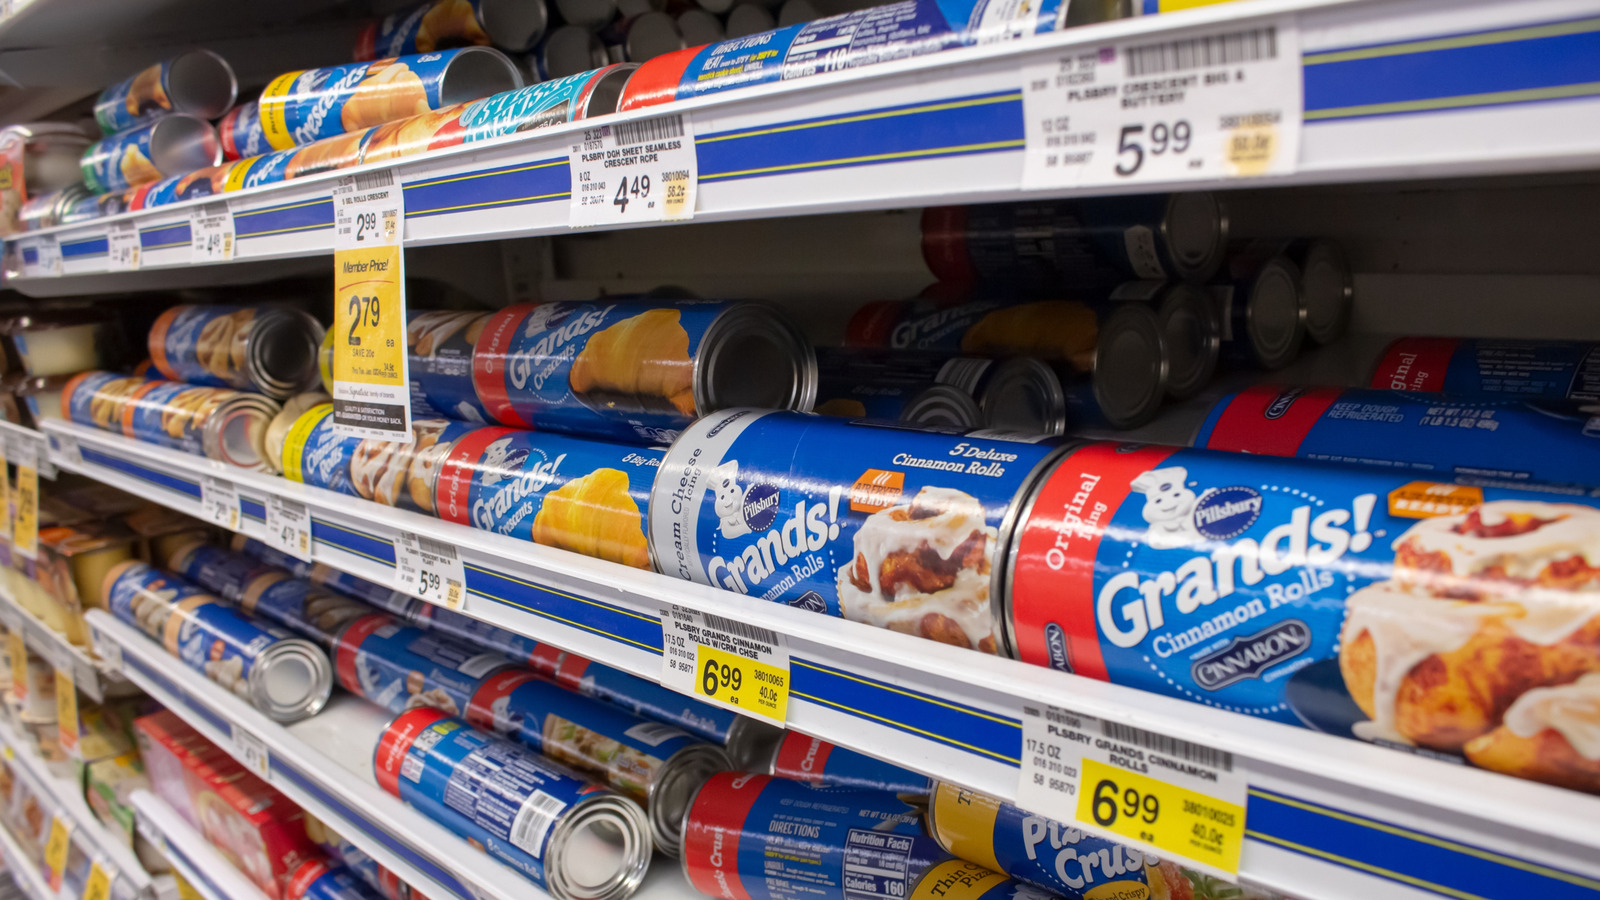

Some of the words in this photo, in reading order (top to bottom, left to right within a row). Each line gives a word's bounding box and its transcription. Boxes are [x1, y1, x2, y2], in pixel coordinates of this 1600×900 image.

[702, 54, 725, 71] HEAT
[784, 61, 816, 80] Calories
[824, 47, 847, 72] 110
[1123, 75, 1198, 95] CRESCENT
[1204, 71, 1230, 86] BIG
[581, 151, 605, 163] PLSBRY
[606, 149, 621, 159] DGH
[622, 146, 643, 157] SHEET
[644, 140, 682, 154] SEAMLESS
[604, 157, 638, 168] CRESCENT
[640, 153, 659, 164] RCPE
[579, 172, 584, 182] 8
[583, 171, 591, 182] OZ
[367, 191, 389, 201] CRESCENT
[343, 261, 369, 274] Member
[369, 259, 389, 272] Price!
[386, 339, 395, 347] ea
[485, 312, 515, 374] Original
[510, 304, 617, 390] Grands!
[534, 343, 576, 390] Crescents
[1327, 410, 1405, 423] REFRIGERATED
[1331, 402, 1362, 411] KEEP
[1361, 404, 1400, 413] DOUGH
[621, 453, 637, 462] 8
[629, 455, 648, 466] Big
[949, 442, 969, 456] 5
[962, 447, 1018, 463] Deluxe
[892, 453, 965, 474] Cinnamon
[964, 462, 1006, 478] Rolls
[449, 452, 470, 517] Original
[473, 453, 567, 532] Grands!
[671, 448, 702, 515] Cheese
[684, 468, 701, 502] Icing
[743, 491, 780, 521] Pillsbury
[1195, 494, 1263, 528] Pillsbury
[1046, 472, 1101, 571] Original
[671, 522, 692, 581] Cream
[708, 485, 842, 595] Grands!
[791, 554, 825, 582] Rolls
[1097, 493, 1378, 648] Grands!
[1152, 598, 1266, 658] Cinnamon
[1264, 568, 1335, 609] Rolls
[664, 633, 676, 645] 17.5
[676, 637, 685, 648] OZ
[674, 621, 700, 636] PLSBRY
[702, 629, 731, 643] GRANDS
[732, 637, 773, 655] CINNAMON
[688, 633, 711, 647] ROLLS
[712, 640, 738, 654] W/CRM
[738, 647, 759, 660] CHSE
[678, 648, 686, 658] 310
[1197, 626, 1301, 686] CINNABON
[669, 659, 677, 669] 58
[678, 661, 694, 675] 95871
[754, 669, 784, 688] 38010065
[730, 695, 739, 704] ea
[759, 685, 778, 702] 40.0¢
[1026, 738, 1045, 755] 17.5
[1046, 745, 1061, 760] OZ
[1047, 724, 1092, 746] PLSBRY
[1095, 738, 1145, 760] GRANDS
[1148, 754, 1218, 782] CINNAMON
[1109, 753, 1149, 774] ROLLS
[1033, 773, 1044, 786] 58
[1049, 776, 1076, 796] 95870
[858, 808, 870, 817] NET
[870, 811, 881, 819] WT
[768, 820, 820, 839] DIRECTIONS
[850, 831, 885, 848] Nutrition
[886, 837, 910, 851] Facts
[1140, 829, 1154, 843] ea
[1191, 822, 1225, 846] 40.0¢
[710, 826, 723, 868] Crust
[845, 877, 877, 892] Calories
[883, 880, 905, 897] 160
[930, 869, 965, 896] Thin
